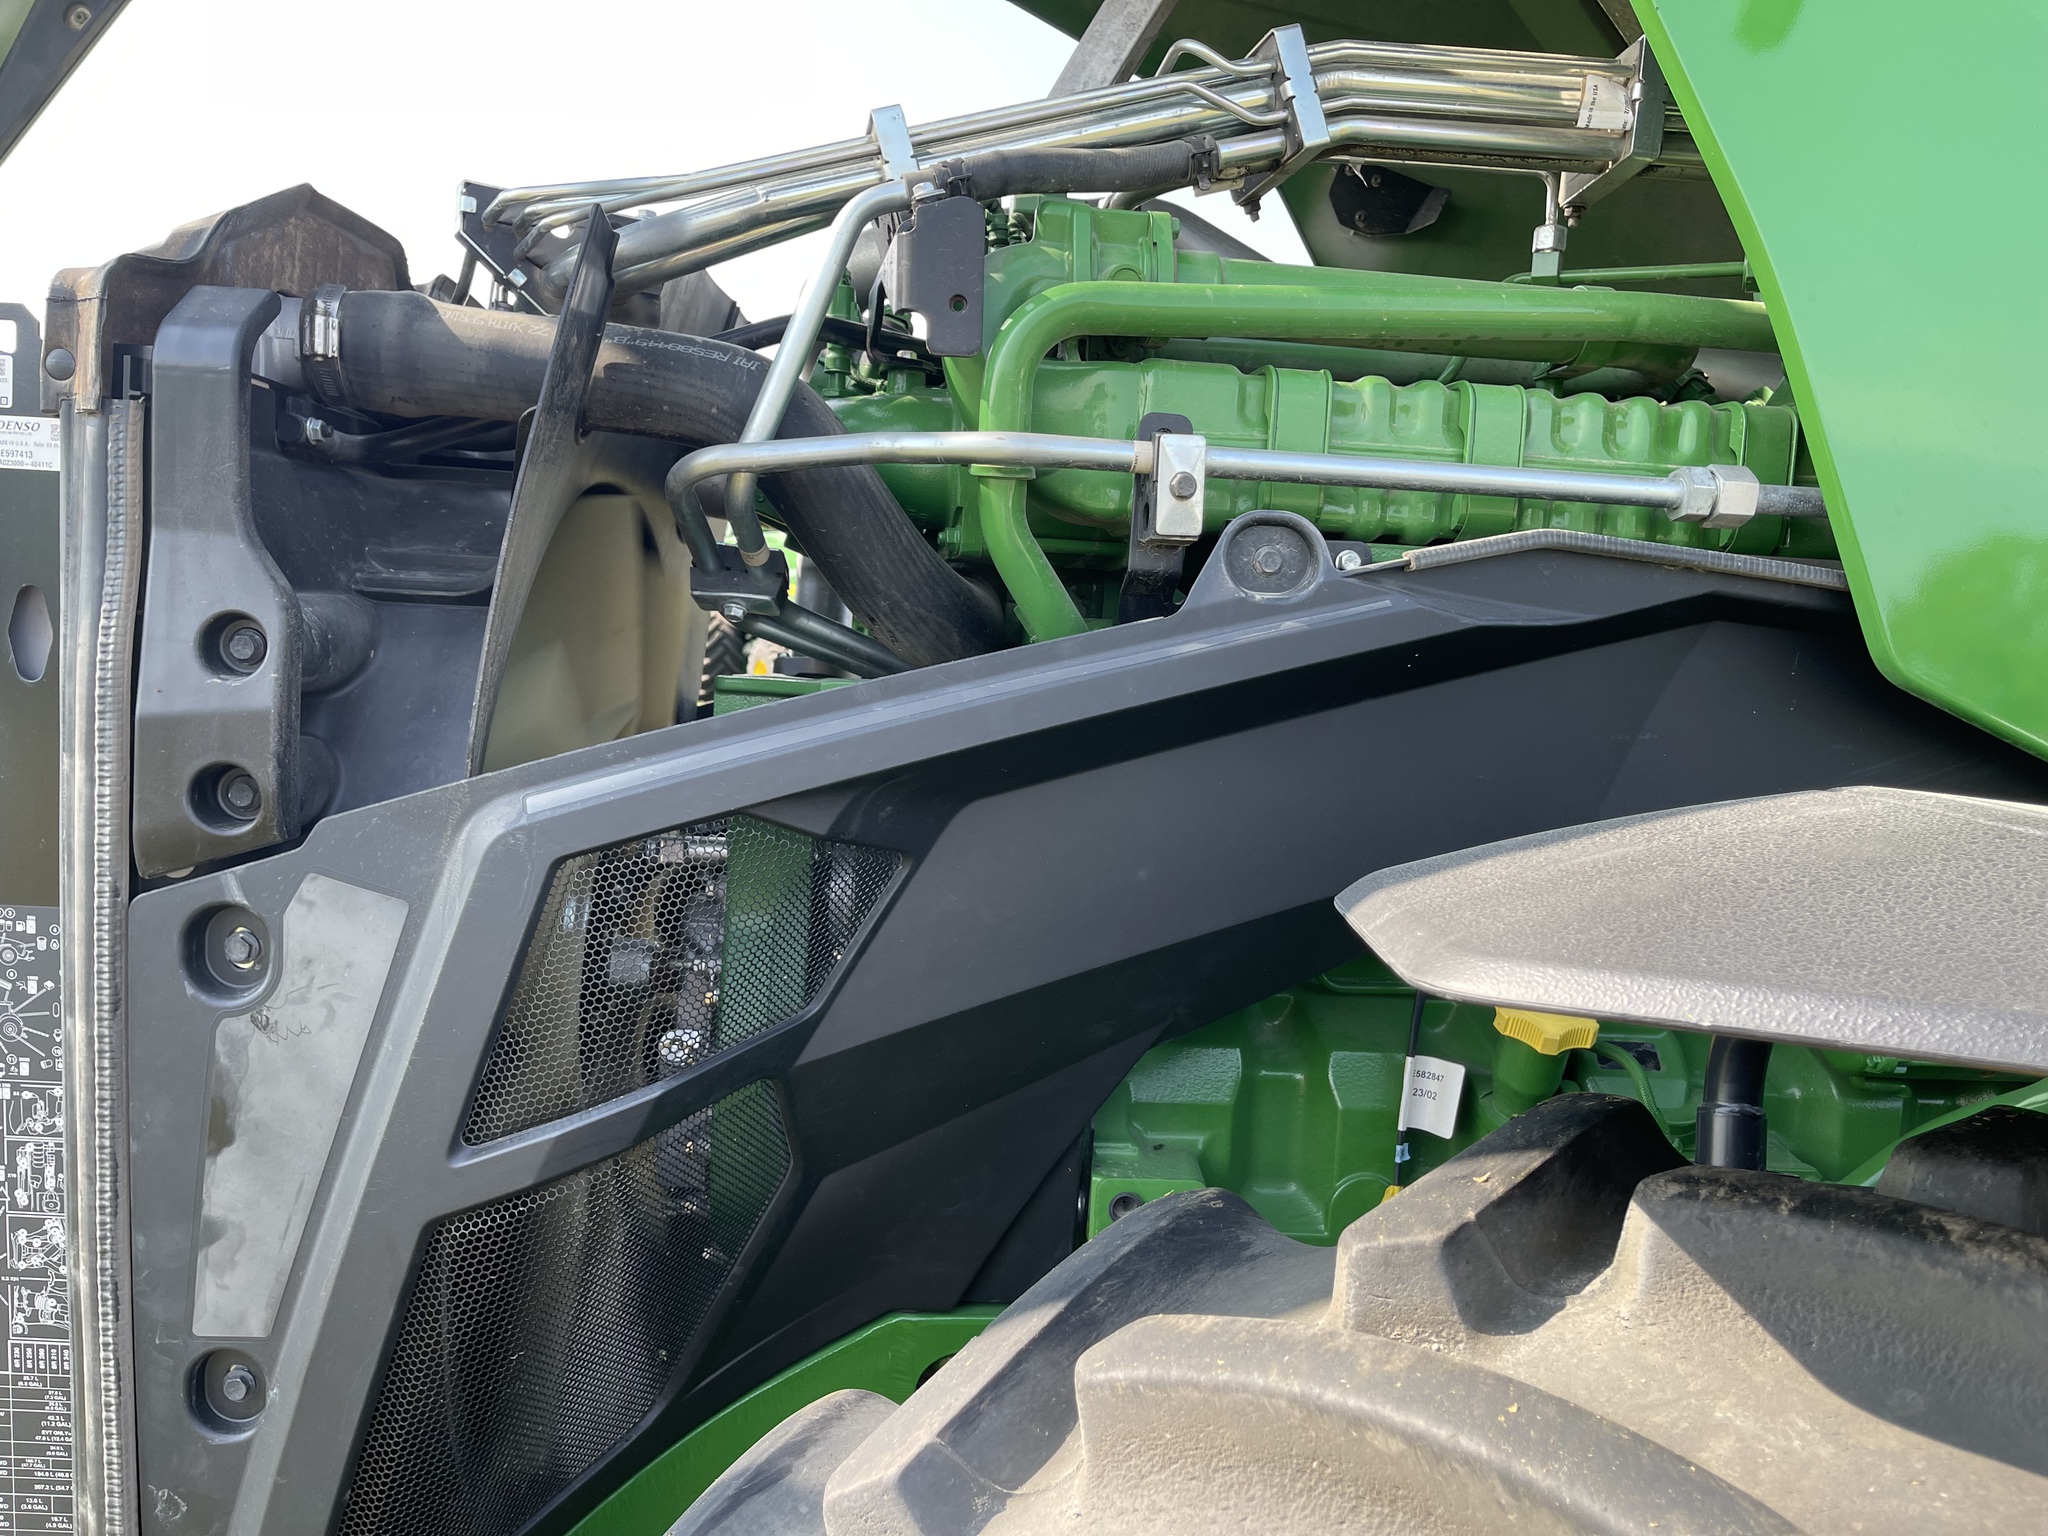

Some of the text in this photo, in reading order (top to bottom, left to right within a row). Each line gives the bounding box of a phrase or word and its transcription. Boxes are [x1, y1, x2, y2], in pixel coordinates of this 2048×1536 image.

[1412, 1087, 1437, 1101] 23/02
[32, 1503, 48, 1511] GAL)
[57, 1522, 72, 1530] GAL)
